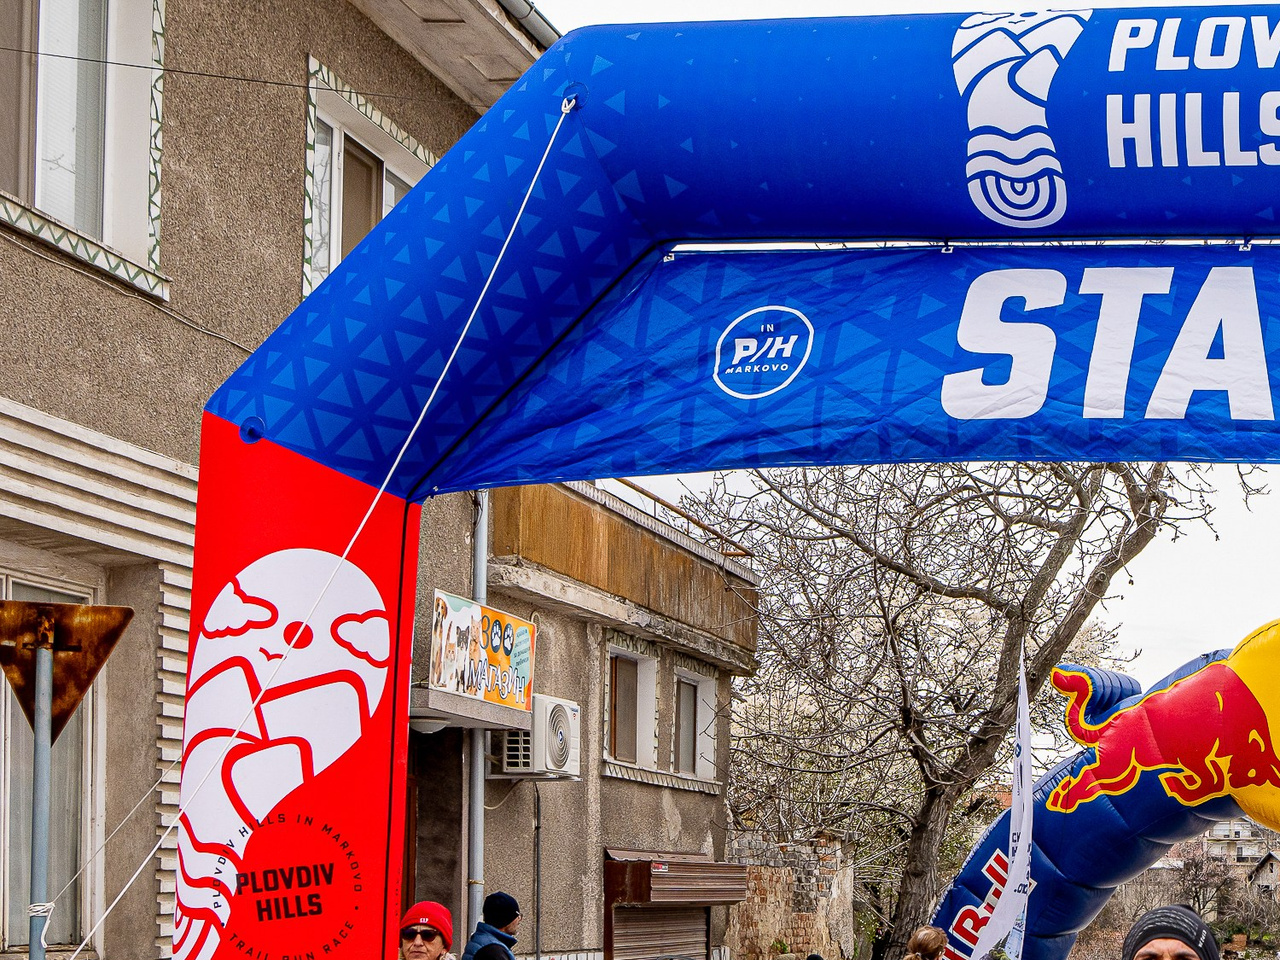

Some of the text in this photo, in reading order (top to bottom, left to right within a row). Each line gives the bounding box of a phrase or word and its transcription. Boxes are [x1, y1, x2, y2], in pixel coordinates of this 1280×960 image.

[760, 324, 775, 332] IN
[732, 335, 799, 365] P/H
[725, 363, 789, 374] MARKOVO
[467, 658, 525, 703] МАГАЗИН
[239, 813, 286, 837] HILLS
[297, 814, 313, 826] IN
[321, 823, 363, 893] MARKOVO
[235, 863, 335, 896] PLOVDIV
[256, 893, 323, 922] HILLS
[325, 920, 354, 954] RACE
